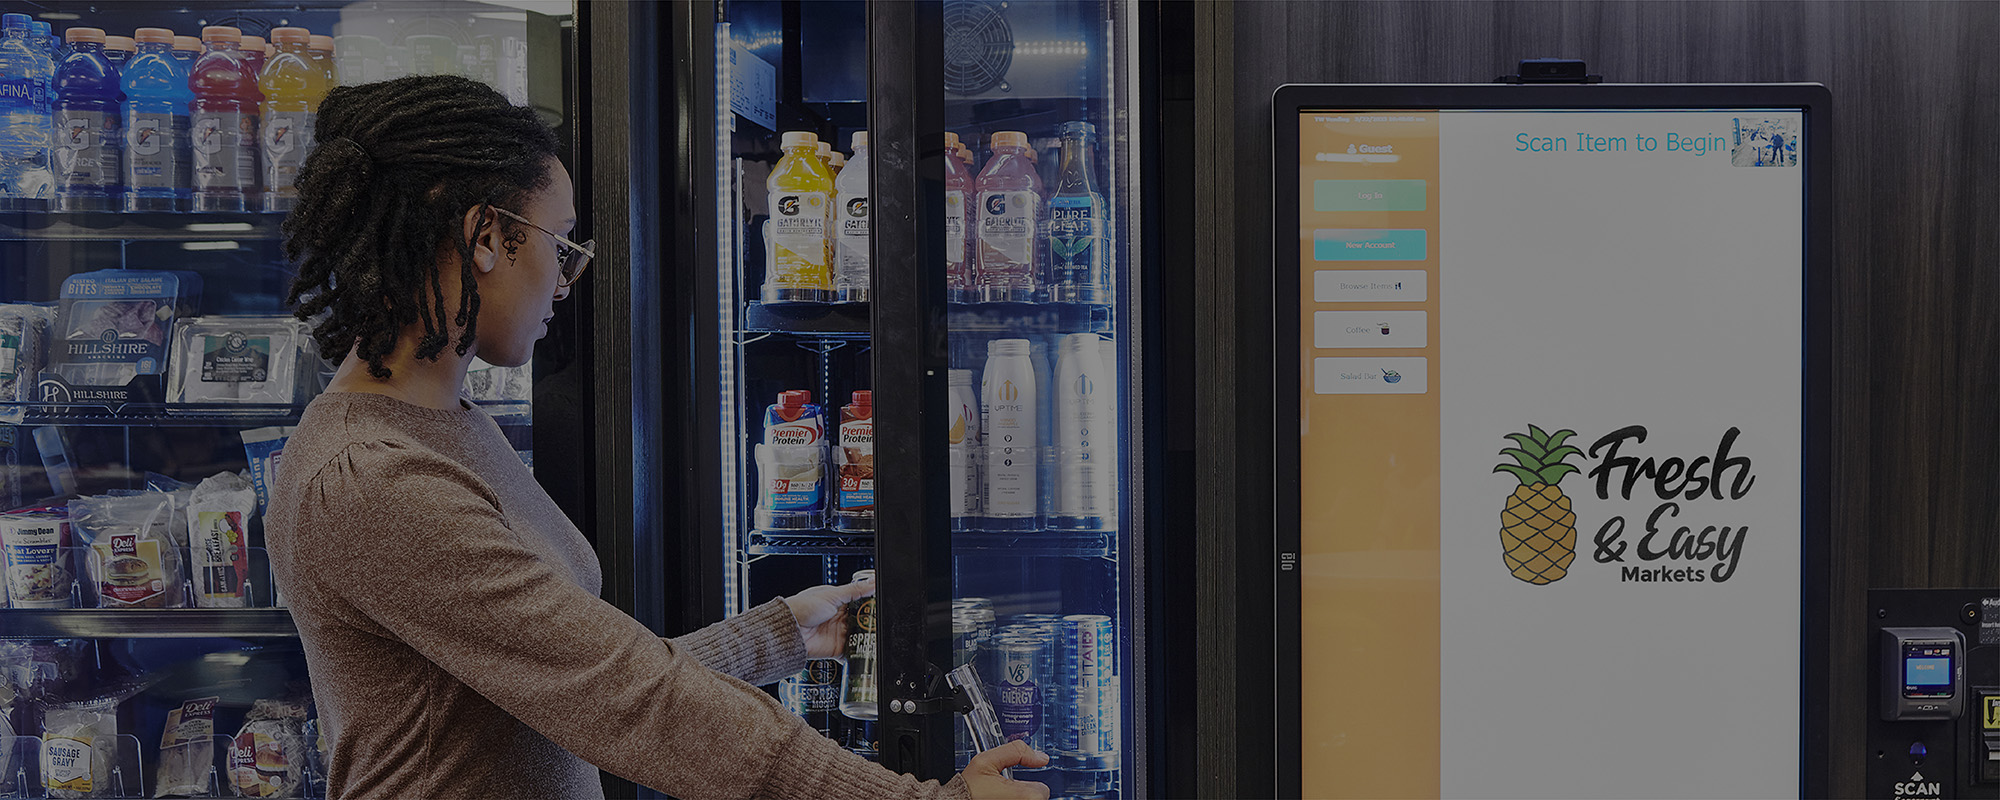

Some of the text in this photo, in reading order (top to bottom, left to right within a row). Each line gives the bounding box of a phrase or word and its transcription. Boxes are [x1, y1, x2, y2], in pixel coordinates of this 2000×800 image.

[1359, 144, 1393, 153] Guest
[1515, 132, 1726, 156] Scan Item to Begin
[1358, 192, 1372, 200] Log
[778, 196, 799, 216] G
[986, 194, 1005, 215] G
[1054, 210, 1088, 219] PURE
[1346, 326, 1370, 334] Coffee
[68, 344, 148, 354] HILLSHIRE
[73, 390, 128, 399] HILLSHIRE
[771, 428, 808, 438] Premier
[842, 426, 873, 436] Premie
[772, 437, 805, 446] Protein
[1588, 425, 1756, 500] Fresh
[252, 457, 265, 506] BURRITO
[17, 527, 54, 535] Jimmy Dean
[113, 537, 134, 548] Deli
[1593, 502, 1748, 583] & Easy
[1621, 565, 1705, 582] Markets
[1009, 664, 1026, 682] V8
[1002, 689, 1034, 704] ENERGY
[185, 701, 213, 713] Deli
[49, 746, 80, 758] SAUSAGE
[53, 757, 75, 767] GRAVY
[1894, 782, 1941, 795] SCAN
